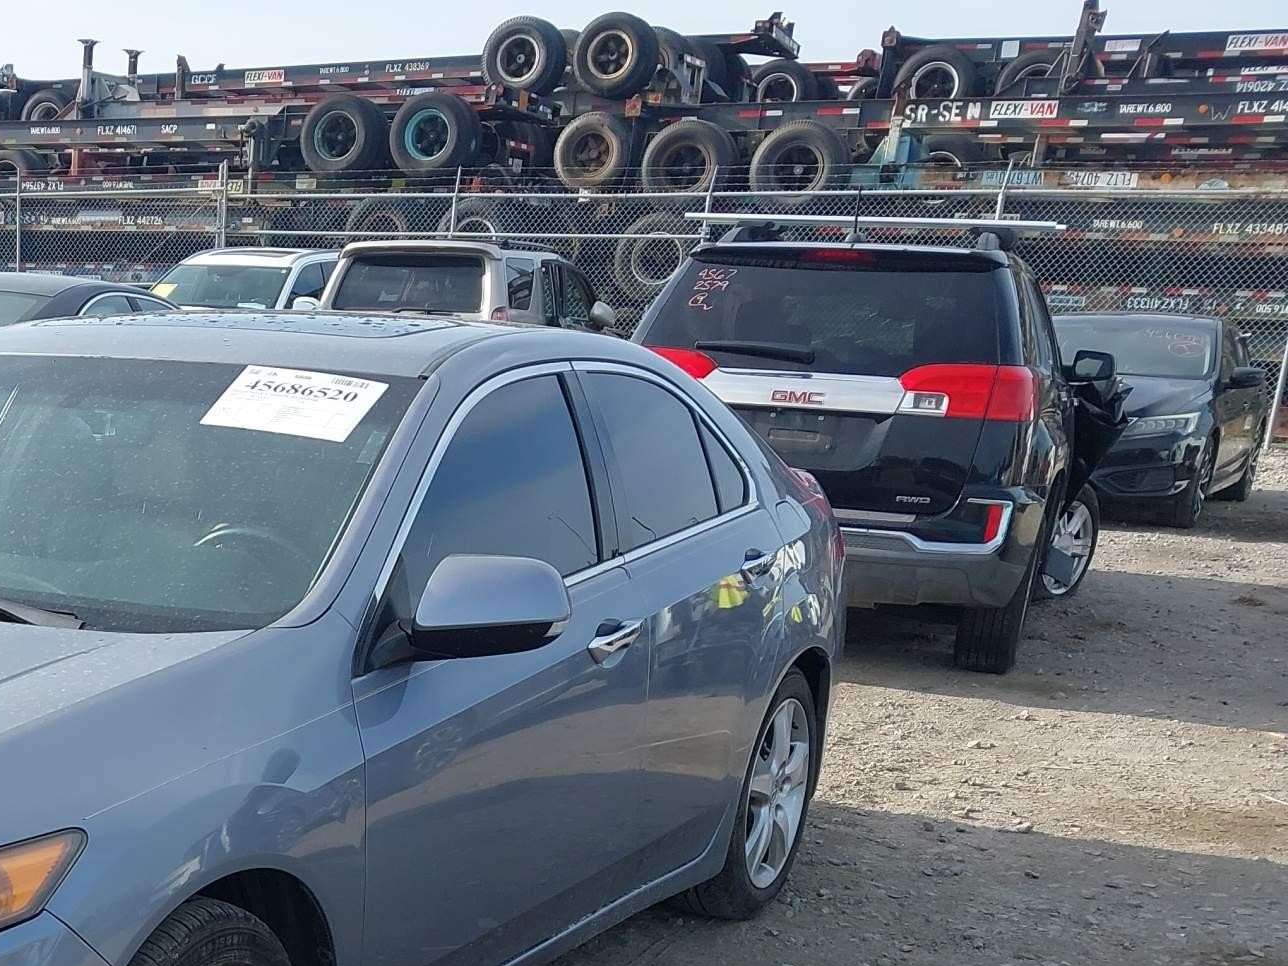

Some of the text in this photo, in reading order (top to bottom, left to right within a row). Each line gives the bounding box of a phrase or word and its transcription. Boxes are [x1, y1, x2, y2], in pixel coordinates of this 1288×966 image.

[385, 63, 402, 73] FLXZ
[245, 71, 284, 81] FLEXI-VAN
[991, 102, 1057, 116] FLEXI-VAN
[1237, 100, 1267, 114] FLXZ
[97, 124, 137, 135] FLXZ 414671
[160, 124, 178, 134] SACP
[118, 215, 135, 225] FLXZ
[1212, 223, 1288, 234] FLXZ 433487
[245, 379, 359, 403] 45686520
[770, 389, 826, 405] GMC
